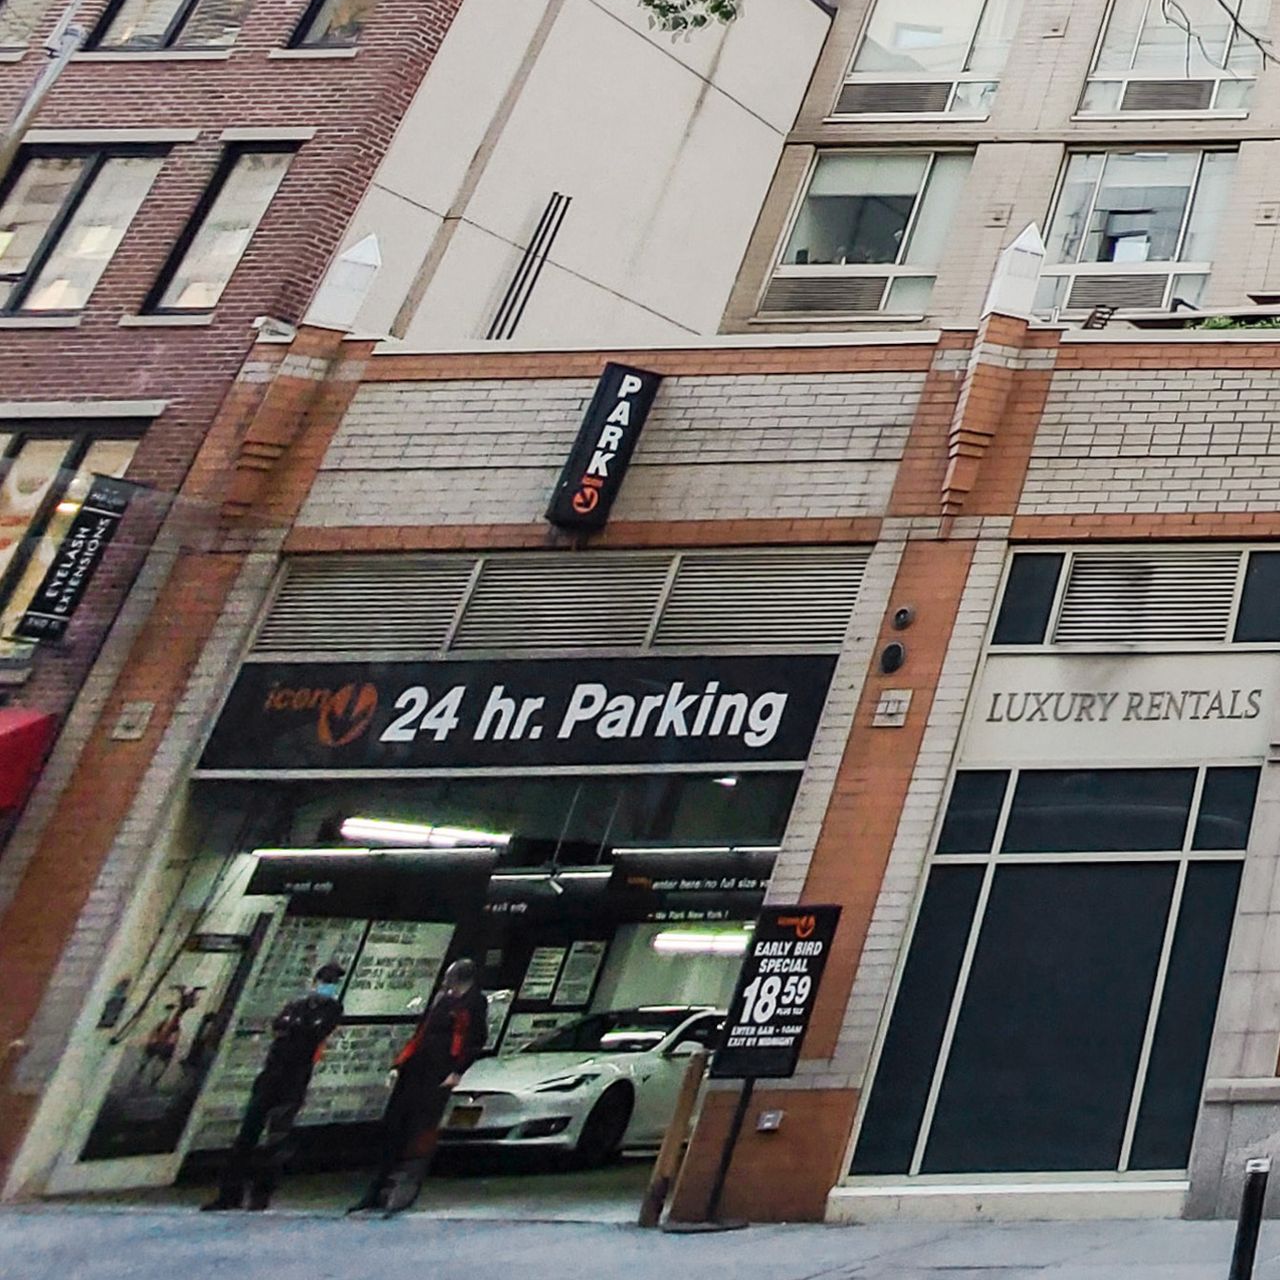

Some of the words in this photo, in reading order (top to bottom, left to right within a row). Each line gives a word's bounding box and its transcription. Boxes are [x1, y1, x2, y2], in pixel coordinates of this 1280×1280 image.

[586, 374, 643, 477] PARK
[45, 526, 92, 598] EYELASH
[54, 518, 112, 613] EXTENSIONS
[379, 686, 466, 742] 24
[473, 685, 547, 741] hr.
[557, 681, 788, 748] Parking
[985, 691, 1120, 722] LUXURY
[1122, 688, 1264, 721] RENTALS
[754, 941, 794, 957] EARLY
[794, 941, 823, 956] BIRD
[759, 958, 809, 973] SPECIAL
[740, 976, 782, 1024] 18
[781, 976, 812, 1005] 59
